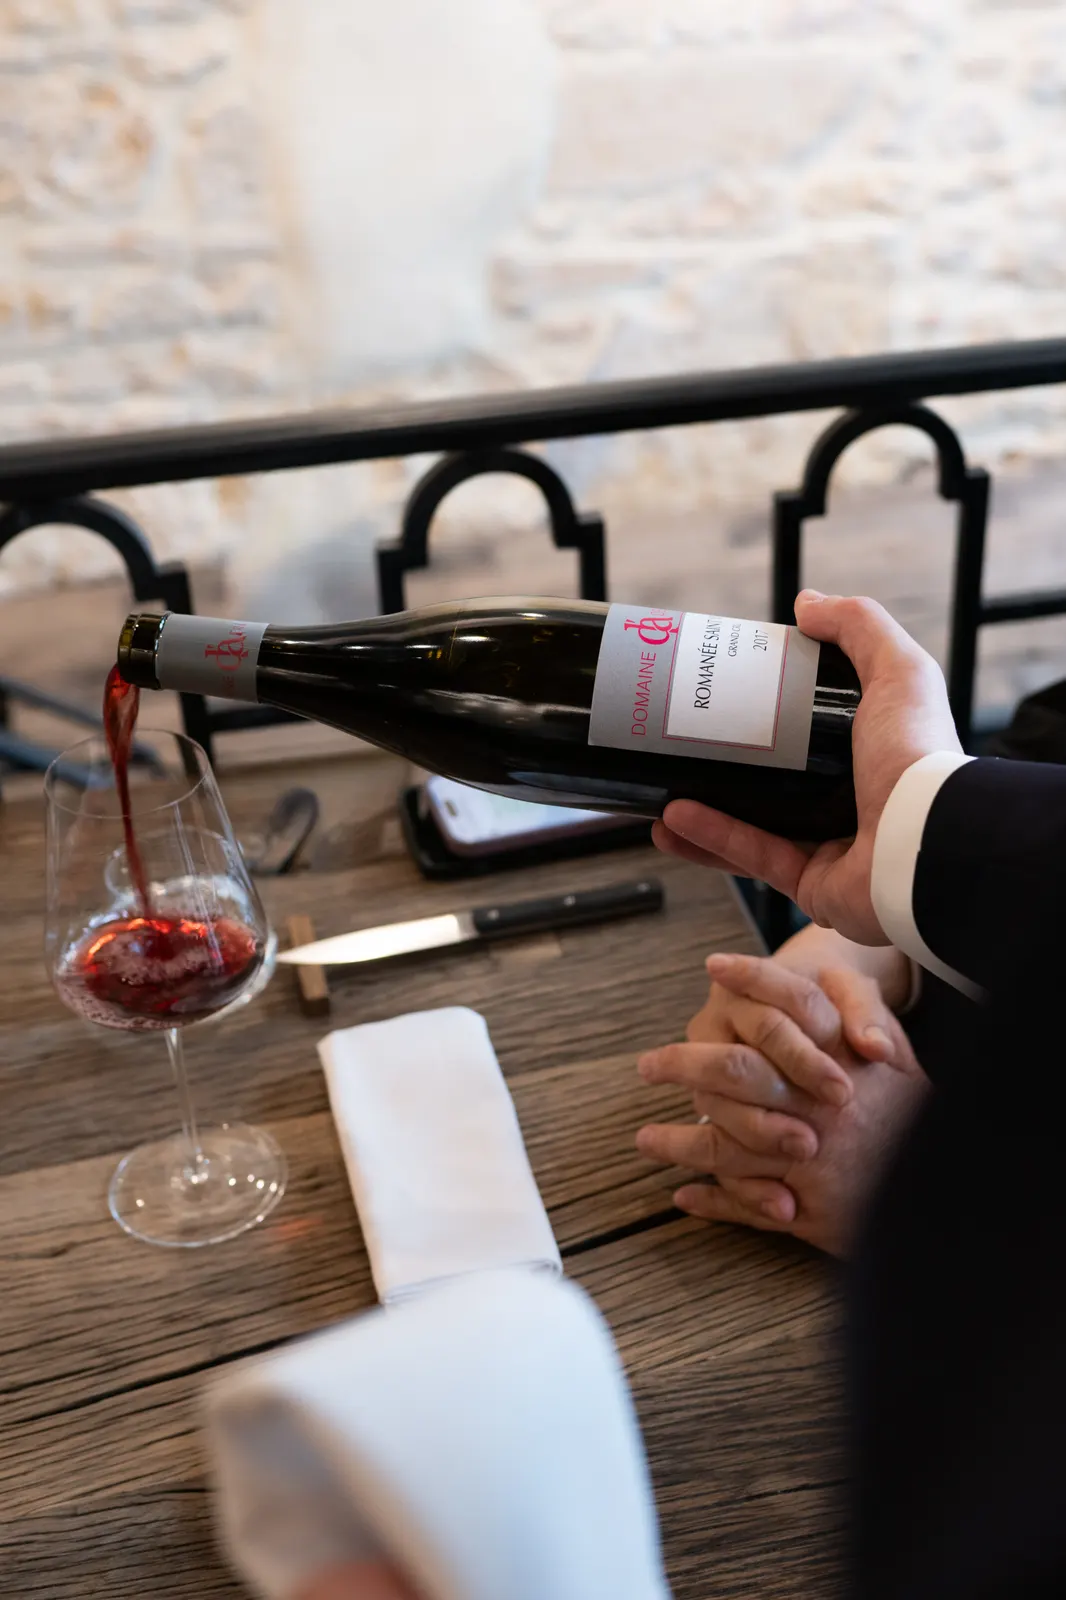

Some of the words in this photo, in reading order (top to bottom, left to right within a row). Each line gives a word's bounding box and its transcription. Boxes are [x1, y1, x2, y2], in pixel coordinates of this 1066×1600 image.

[727, 632, 740, 657] GRAND
[752, 629, 769, 652] 2017
[631, 651, 657, 736] DOMAINE
[693, 642, 719, 710] ROMANÉE
